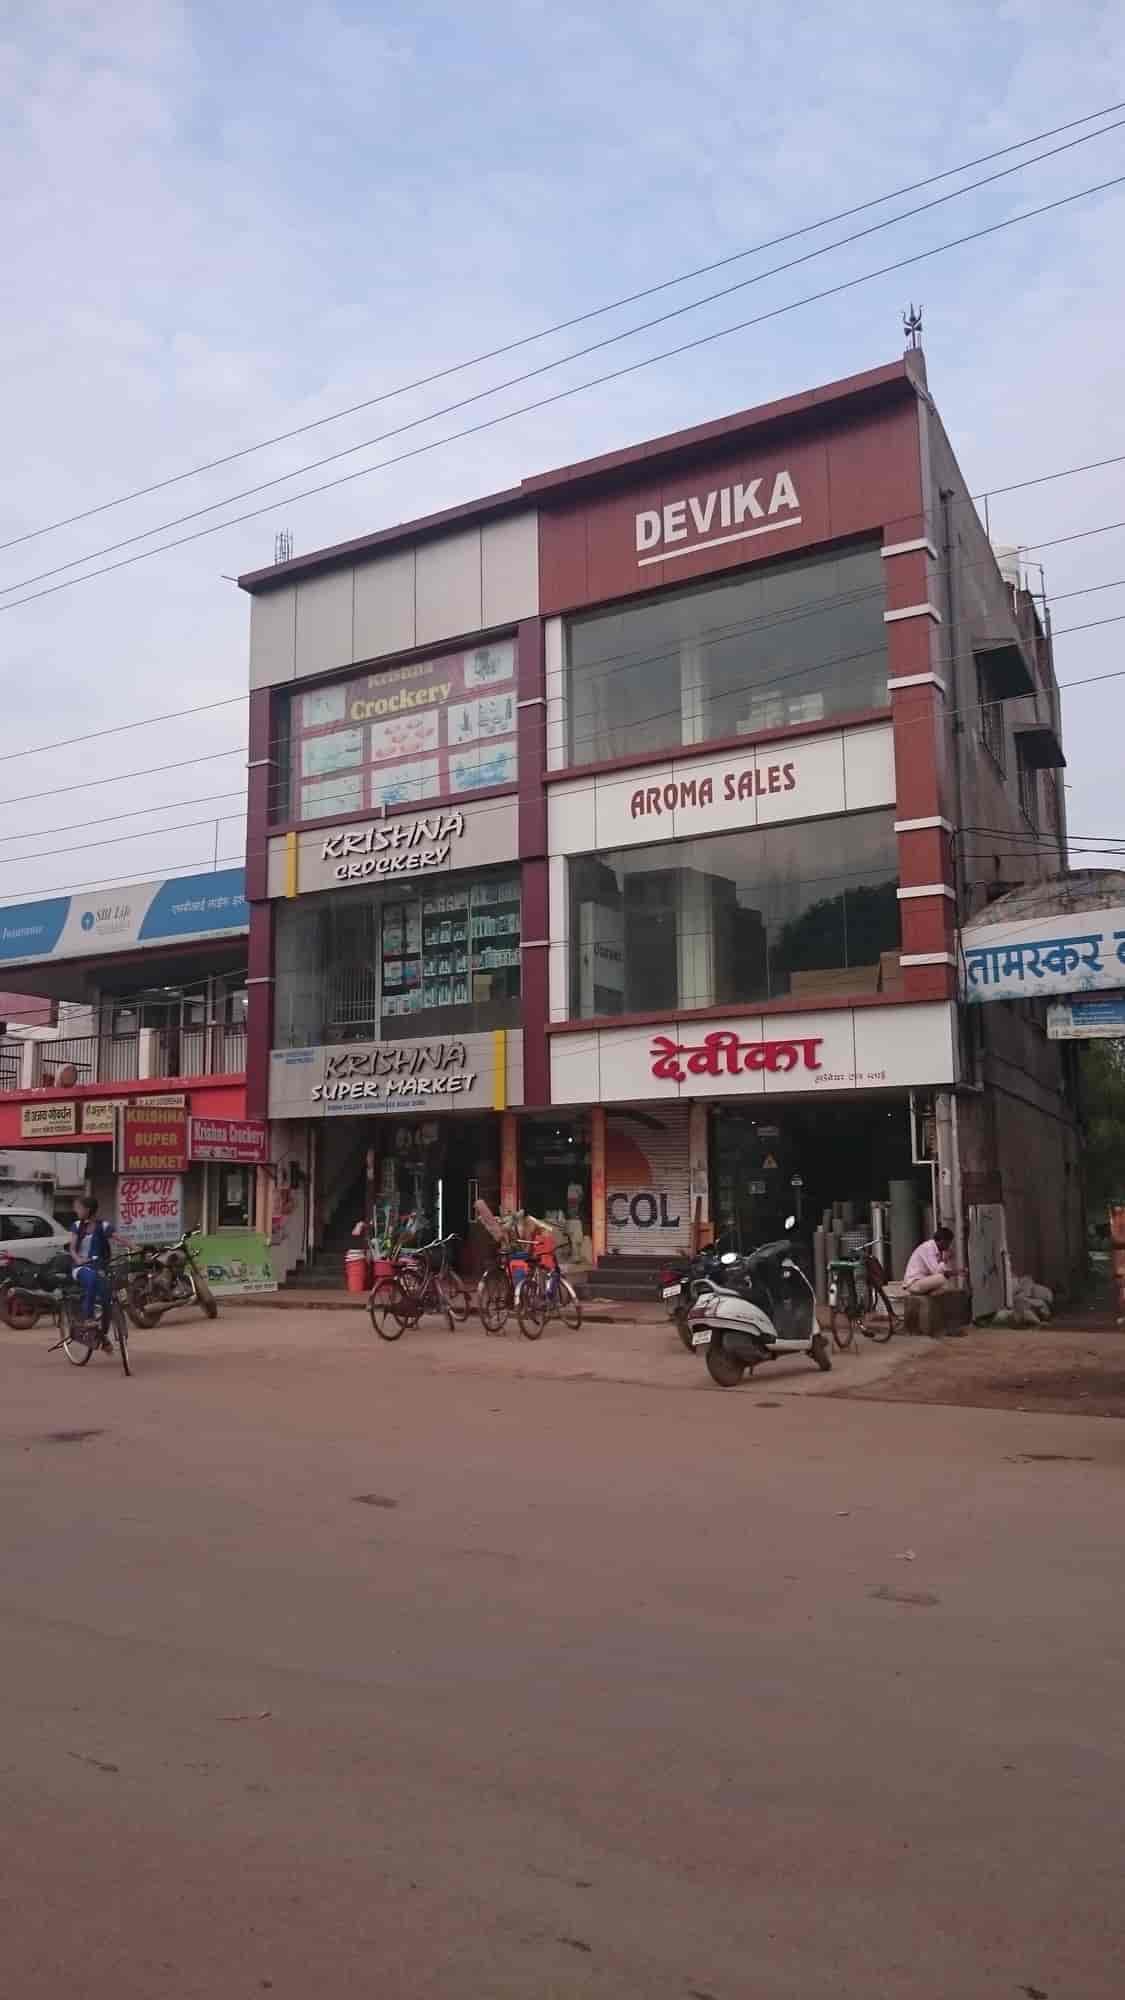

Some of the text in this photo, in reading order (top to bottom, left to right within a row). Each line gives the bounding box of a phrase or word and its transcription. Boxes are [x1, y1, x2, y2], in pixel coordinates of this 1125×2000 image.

[635, 471, 800, 551] DEVIKA
[350, 681, 452, 721] Crockery
[630, 763, 797, 820] AROMA SALES
[321, 812, 466, 861] KRISHNA
[334, 847, 452, 881] CROCKERY
[325, 1041, 467, 1081] KRISHNA
[649, 1031, 824, 1083] देवीका
[311, 1073, 478, 1103] SUPER MARKET
[127, 1108, 184, 1123] KRISHNA
[135, 1132, 177, 1147] SUPER
[194, 1121, 265, 1148] Krishna Crockery
[128, 1156, 184, 1170] MARKET
[608, 1192, 681, 1228] COL
